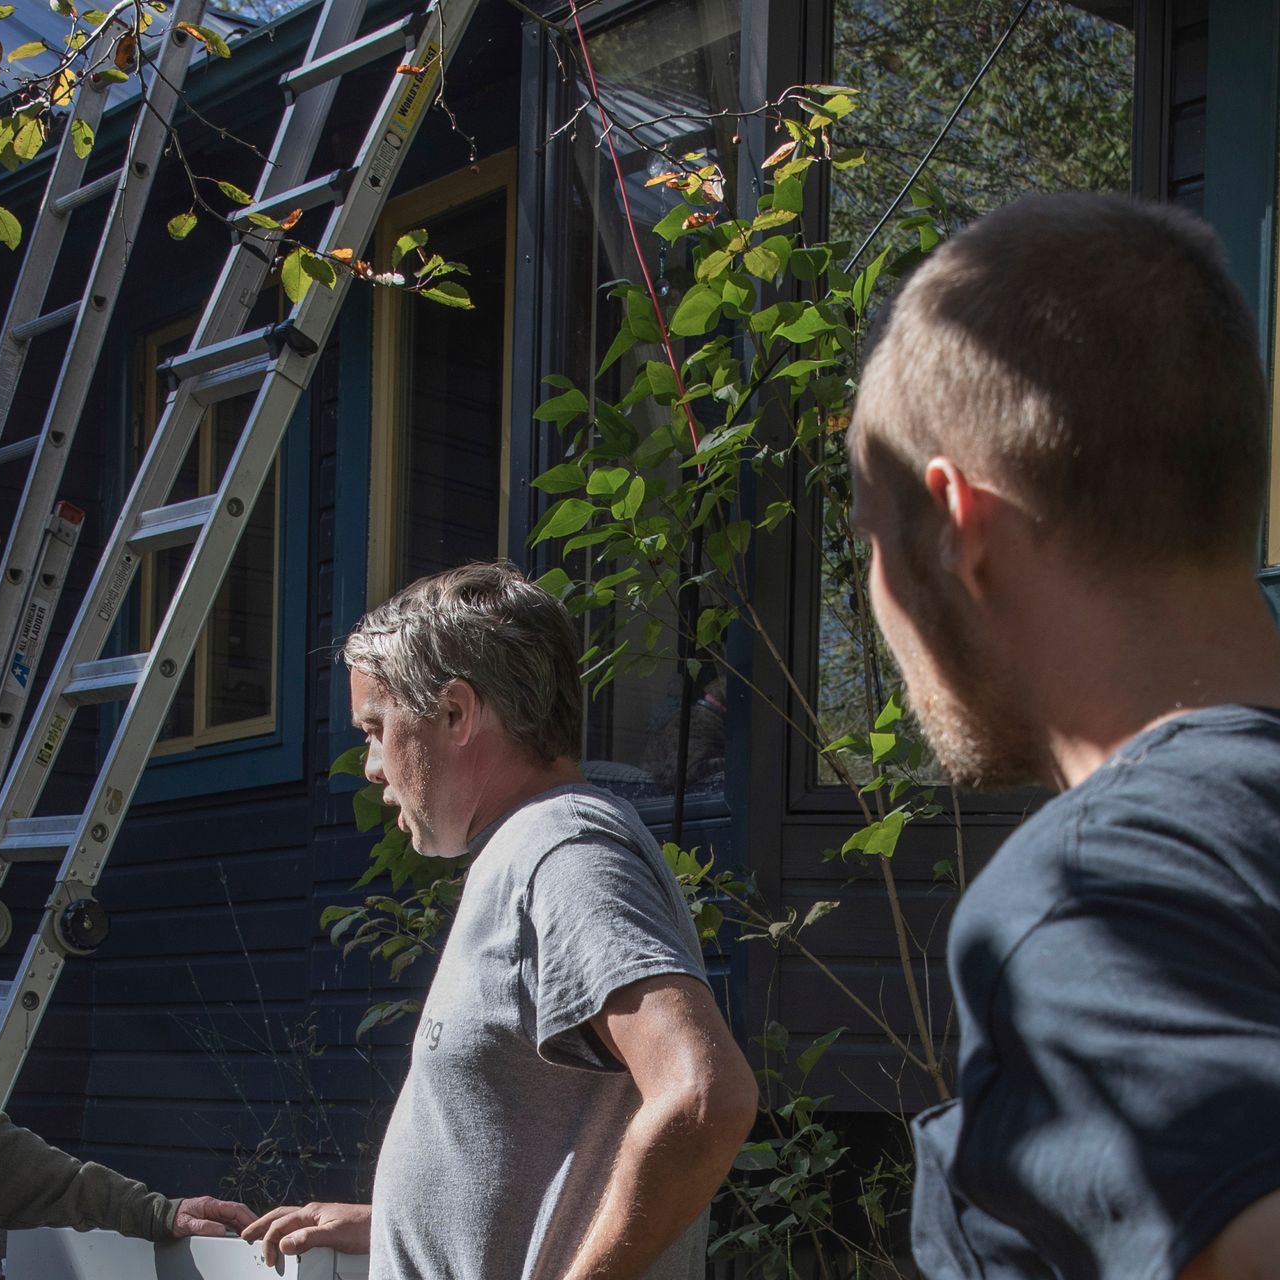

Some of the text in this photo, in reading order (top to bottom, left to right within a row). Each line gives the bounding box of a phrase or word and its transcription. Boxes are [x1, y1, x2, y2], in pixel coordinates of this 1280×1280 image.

[398, 84, 420, 117] WORLD'S
[19, 602, 37, 652] ALL AMERICAN
[30, 606, 46, 641] LADDER
[419, 1008, 444, 1051] ing
